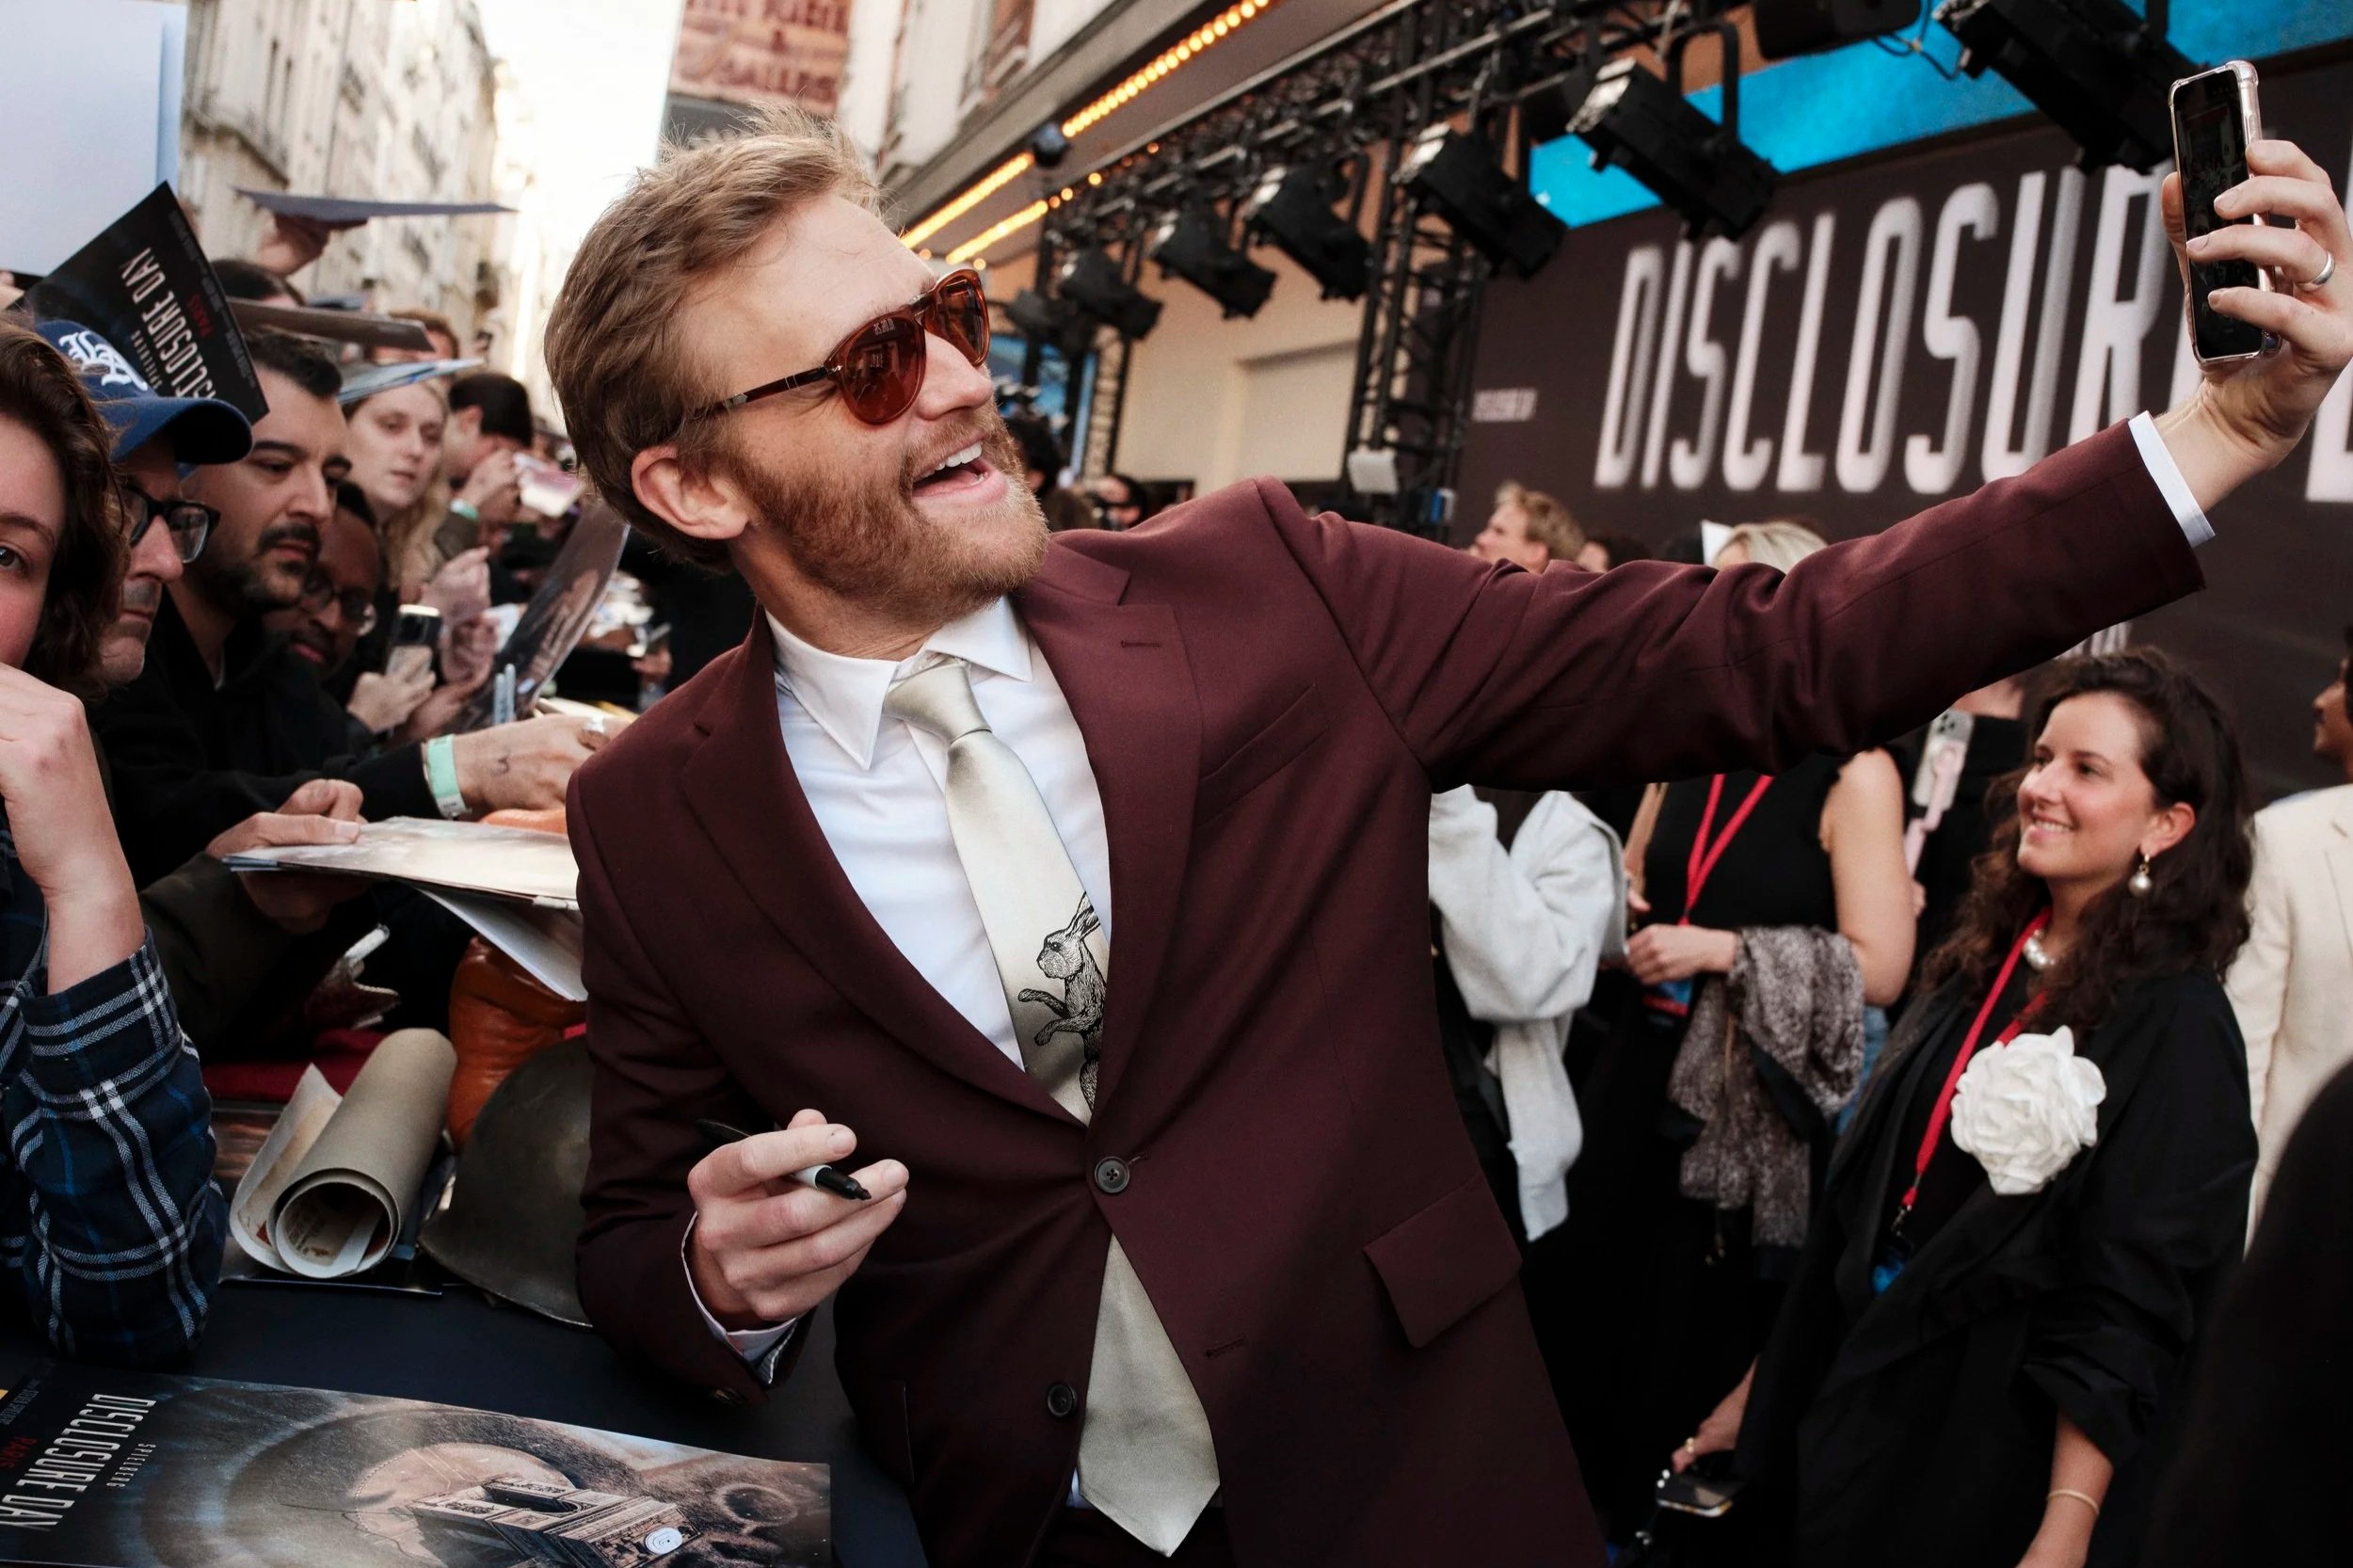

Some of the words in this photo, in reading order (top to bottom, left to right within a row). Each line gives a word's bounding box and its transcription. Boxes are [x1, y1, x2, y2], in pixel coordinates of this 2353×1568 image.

[119, 247, 167, 304] DAY
[140, 290, 216, 399] SCLOSURE
[1594, 158, 2208, 493] DISCLOSUR
[16, 1393, 157, 1493] DISCLOSURE
[106, 1443, 157, 1487] SPIELBERG
[0, 1494, 75, 1531] DAY
